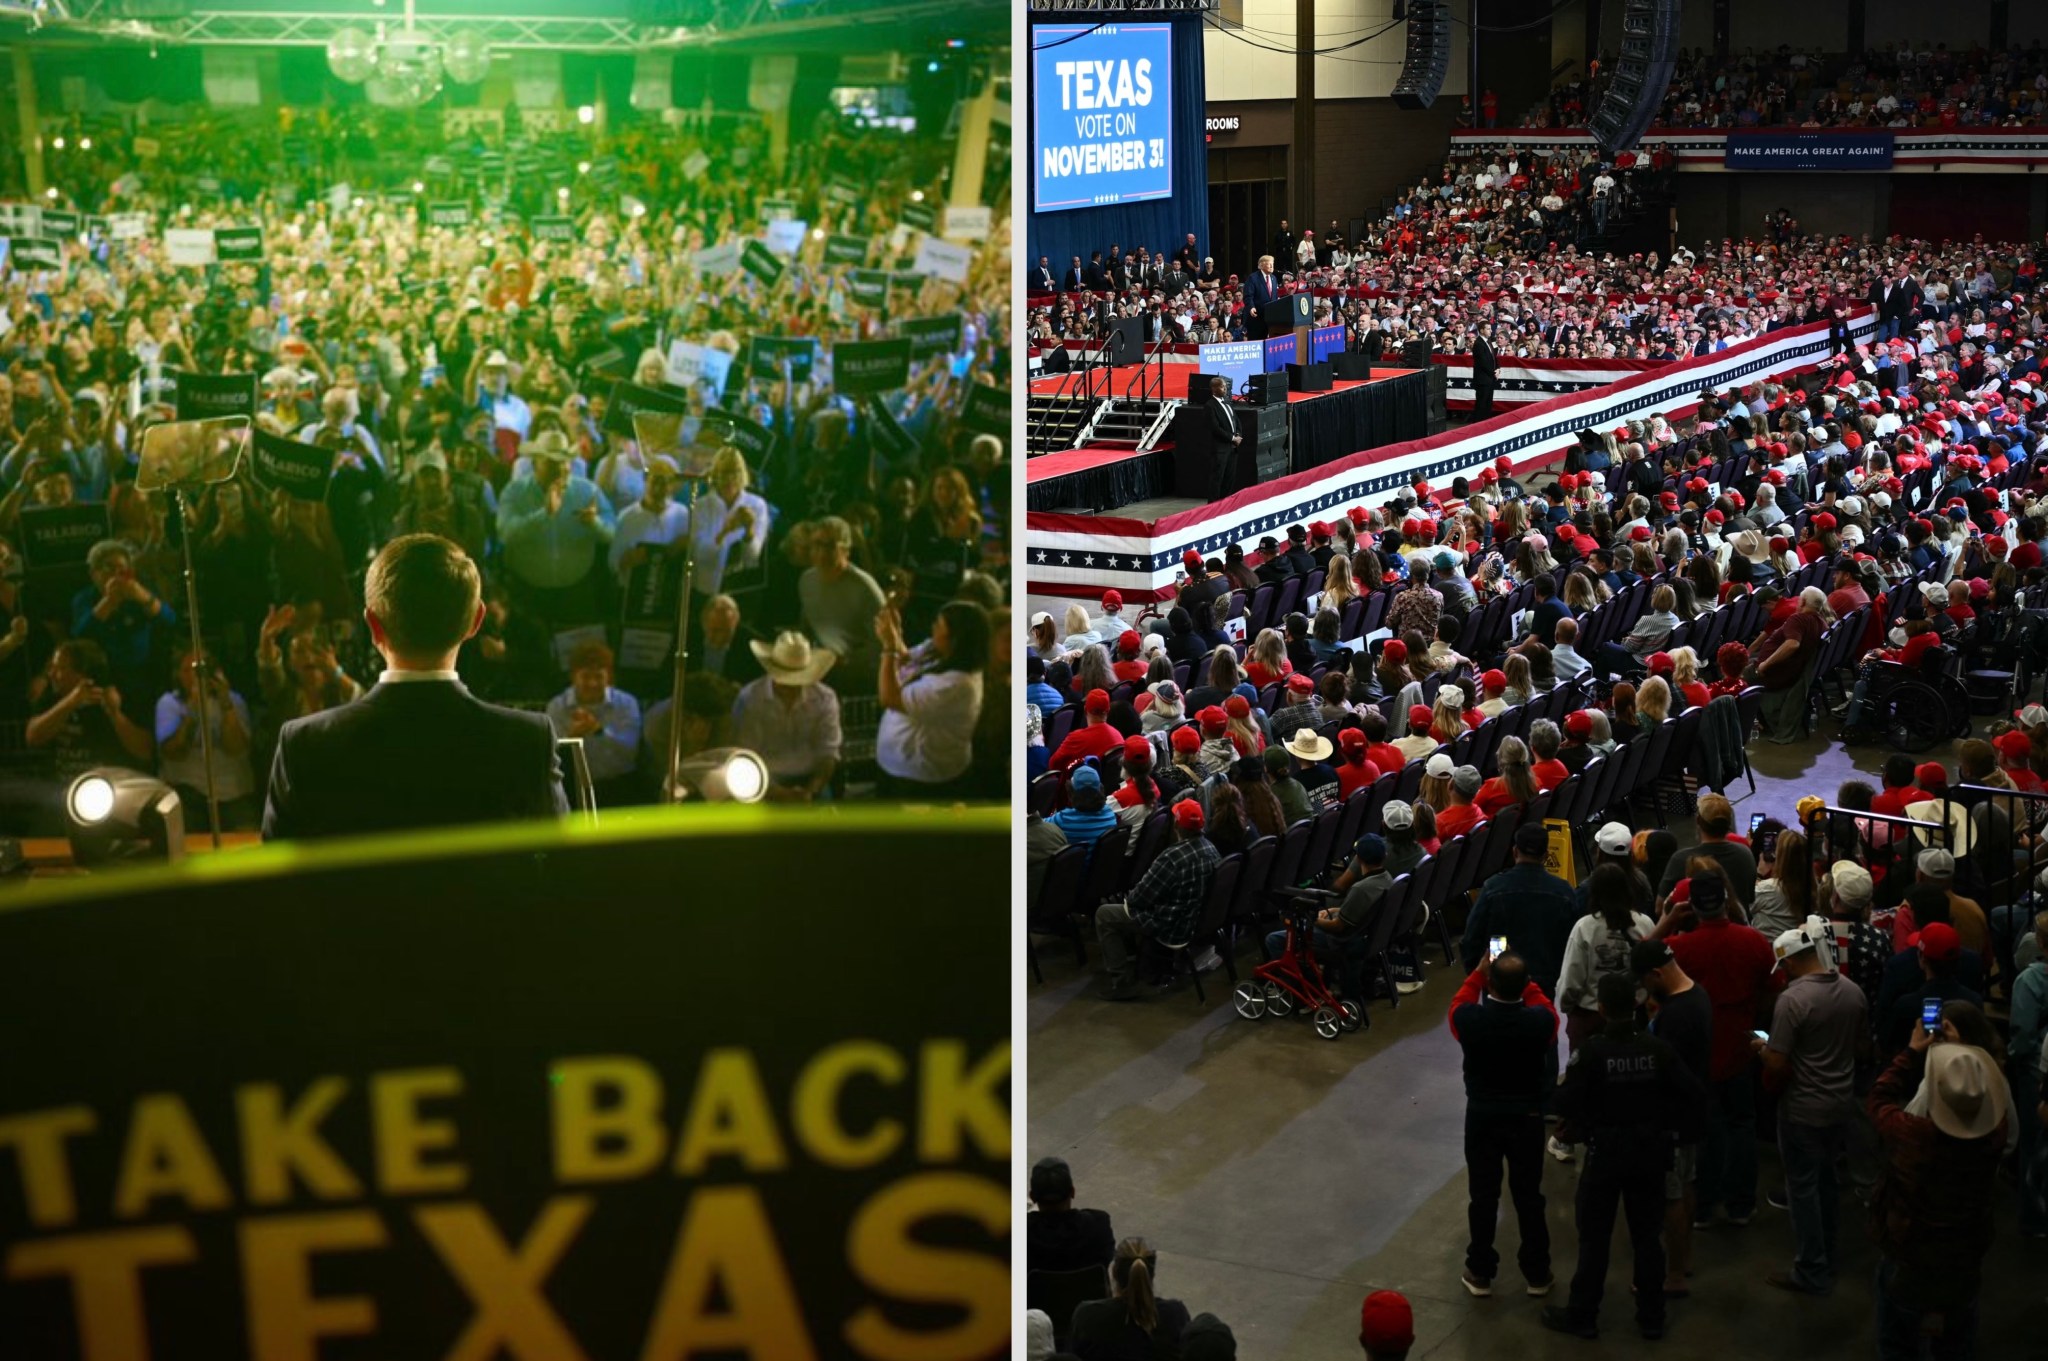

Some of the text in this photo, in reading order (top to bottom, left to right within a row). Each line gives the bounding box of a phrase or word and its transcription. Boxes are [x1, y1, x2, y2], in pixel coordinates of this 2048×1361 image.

[1056, 58, 1153, 110] TEXAS
[1075, 112, 1136, 139] VOTE ON
[1044, 138, 1164, 178] NOVEMBER 3!
[1734, 147, 1884, 156] MAKE AMERICA GREAT AGAIN!
[1204, 344, 1261, 355] MAKE AMERICA
[1207, 352, 1260, 362] GREAT AGAIN!
[258, 447, 321, 479] TALARICO
[1607, 1055, 1656, 1073] POLICE
[0, 1038, 1011, 1228] TAKE BACK
[5, 1171, 1011, 1361] TEXAS
